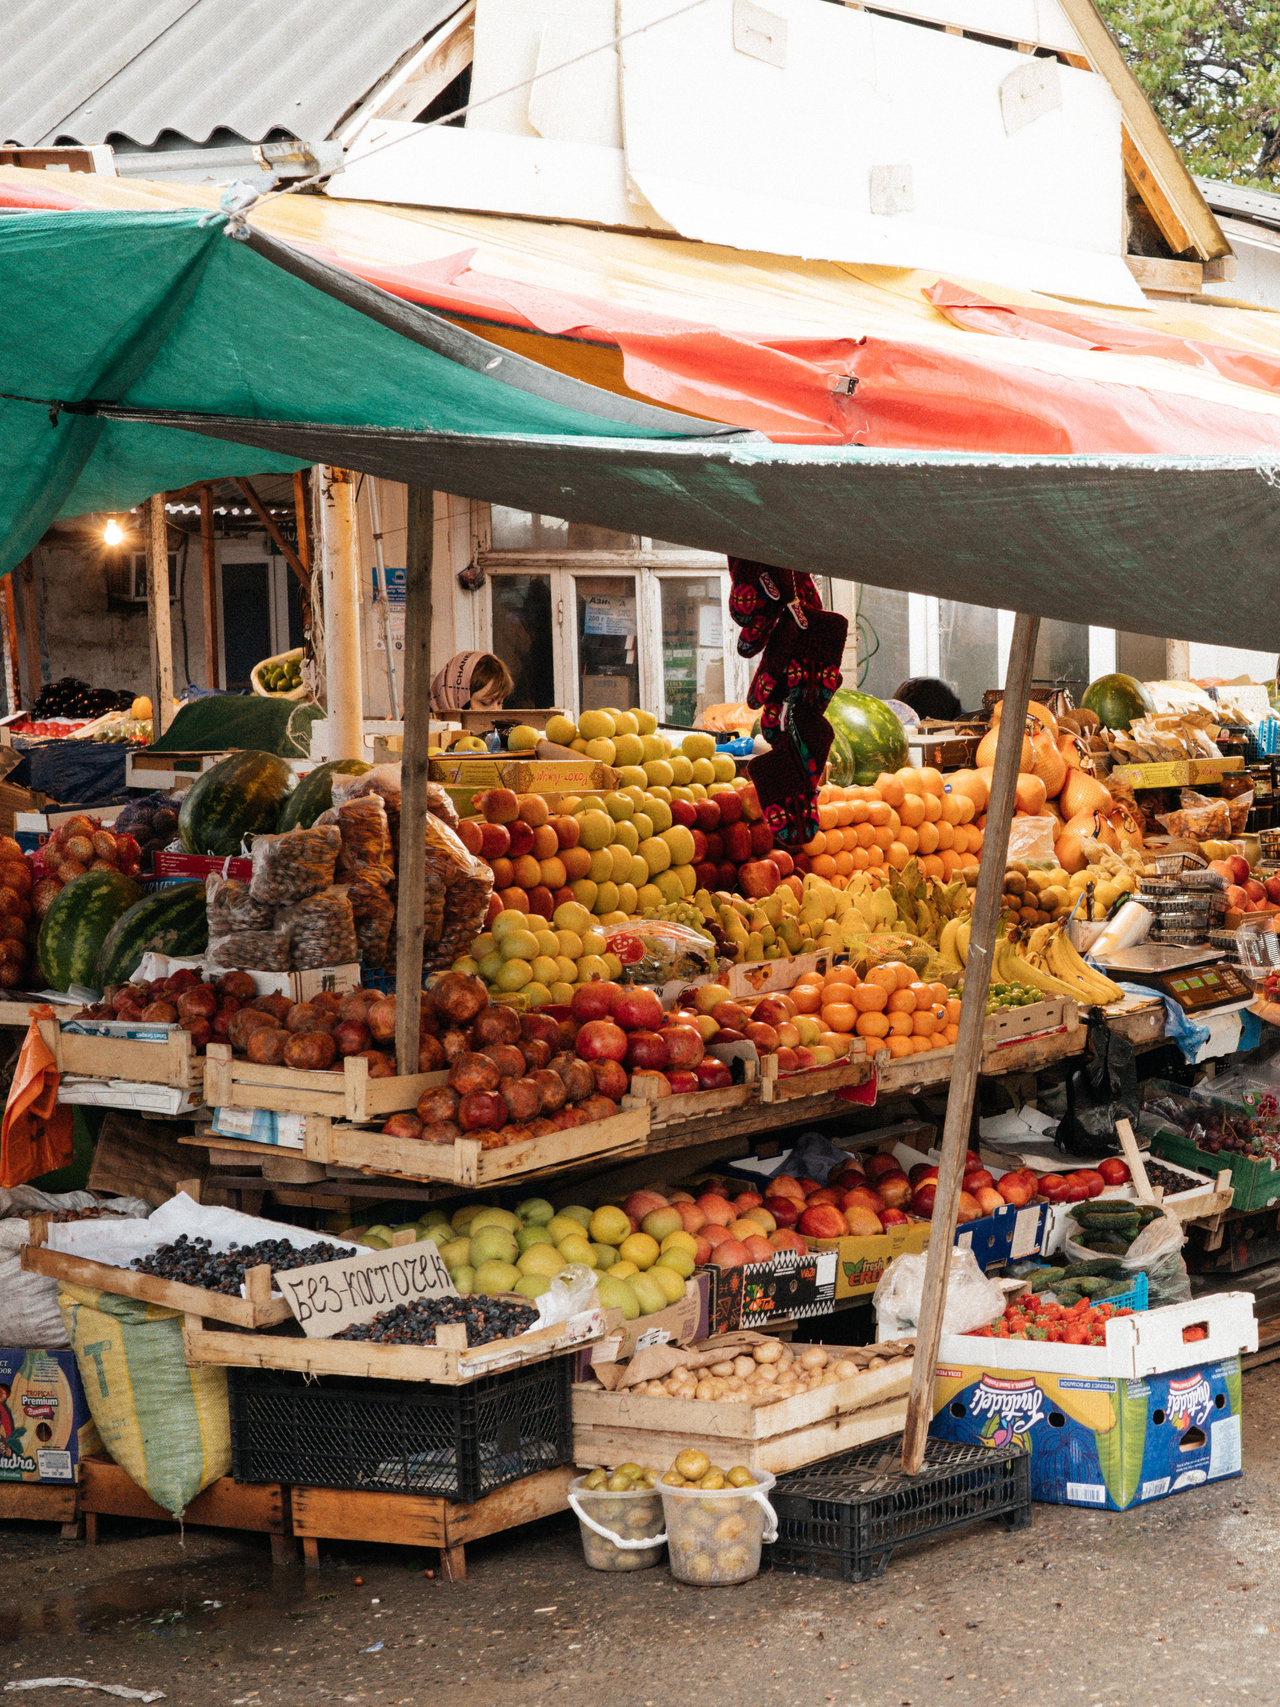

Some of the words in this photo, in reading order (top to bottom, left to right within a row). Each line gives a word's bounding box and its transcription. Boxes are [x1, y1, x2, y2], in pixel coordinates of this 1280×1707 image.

[863, 1257, 883, 1272] fresh
[22, 1396, 58, 1405] Premium
[969, 1389, 1045, 1434] Frutadeli
[1166, 1381, 1214, 1425] Frutadeli
